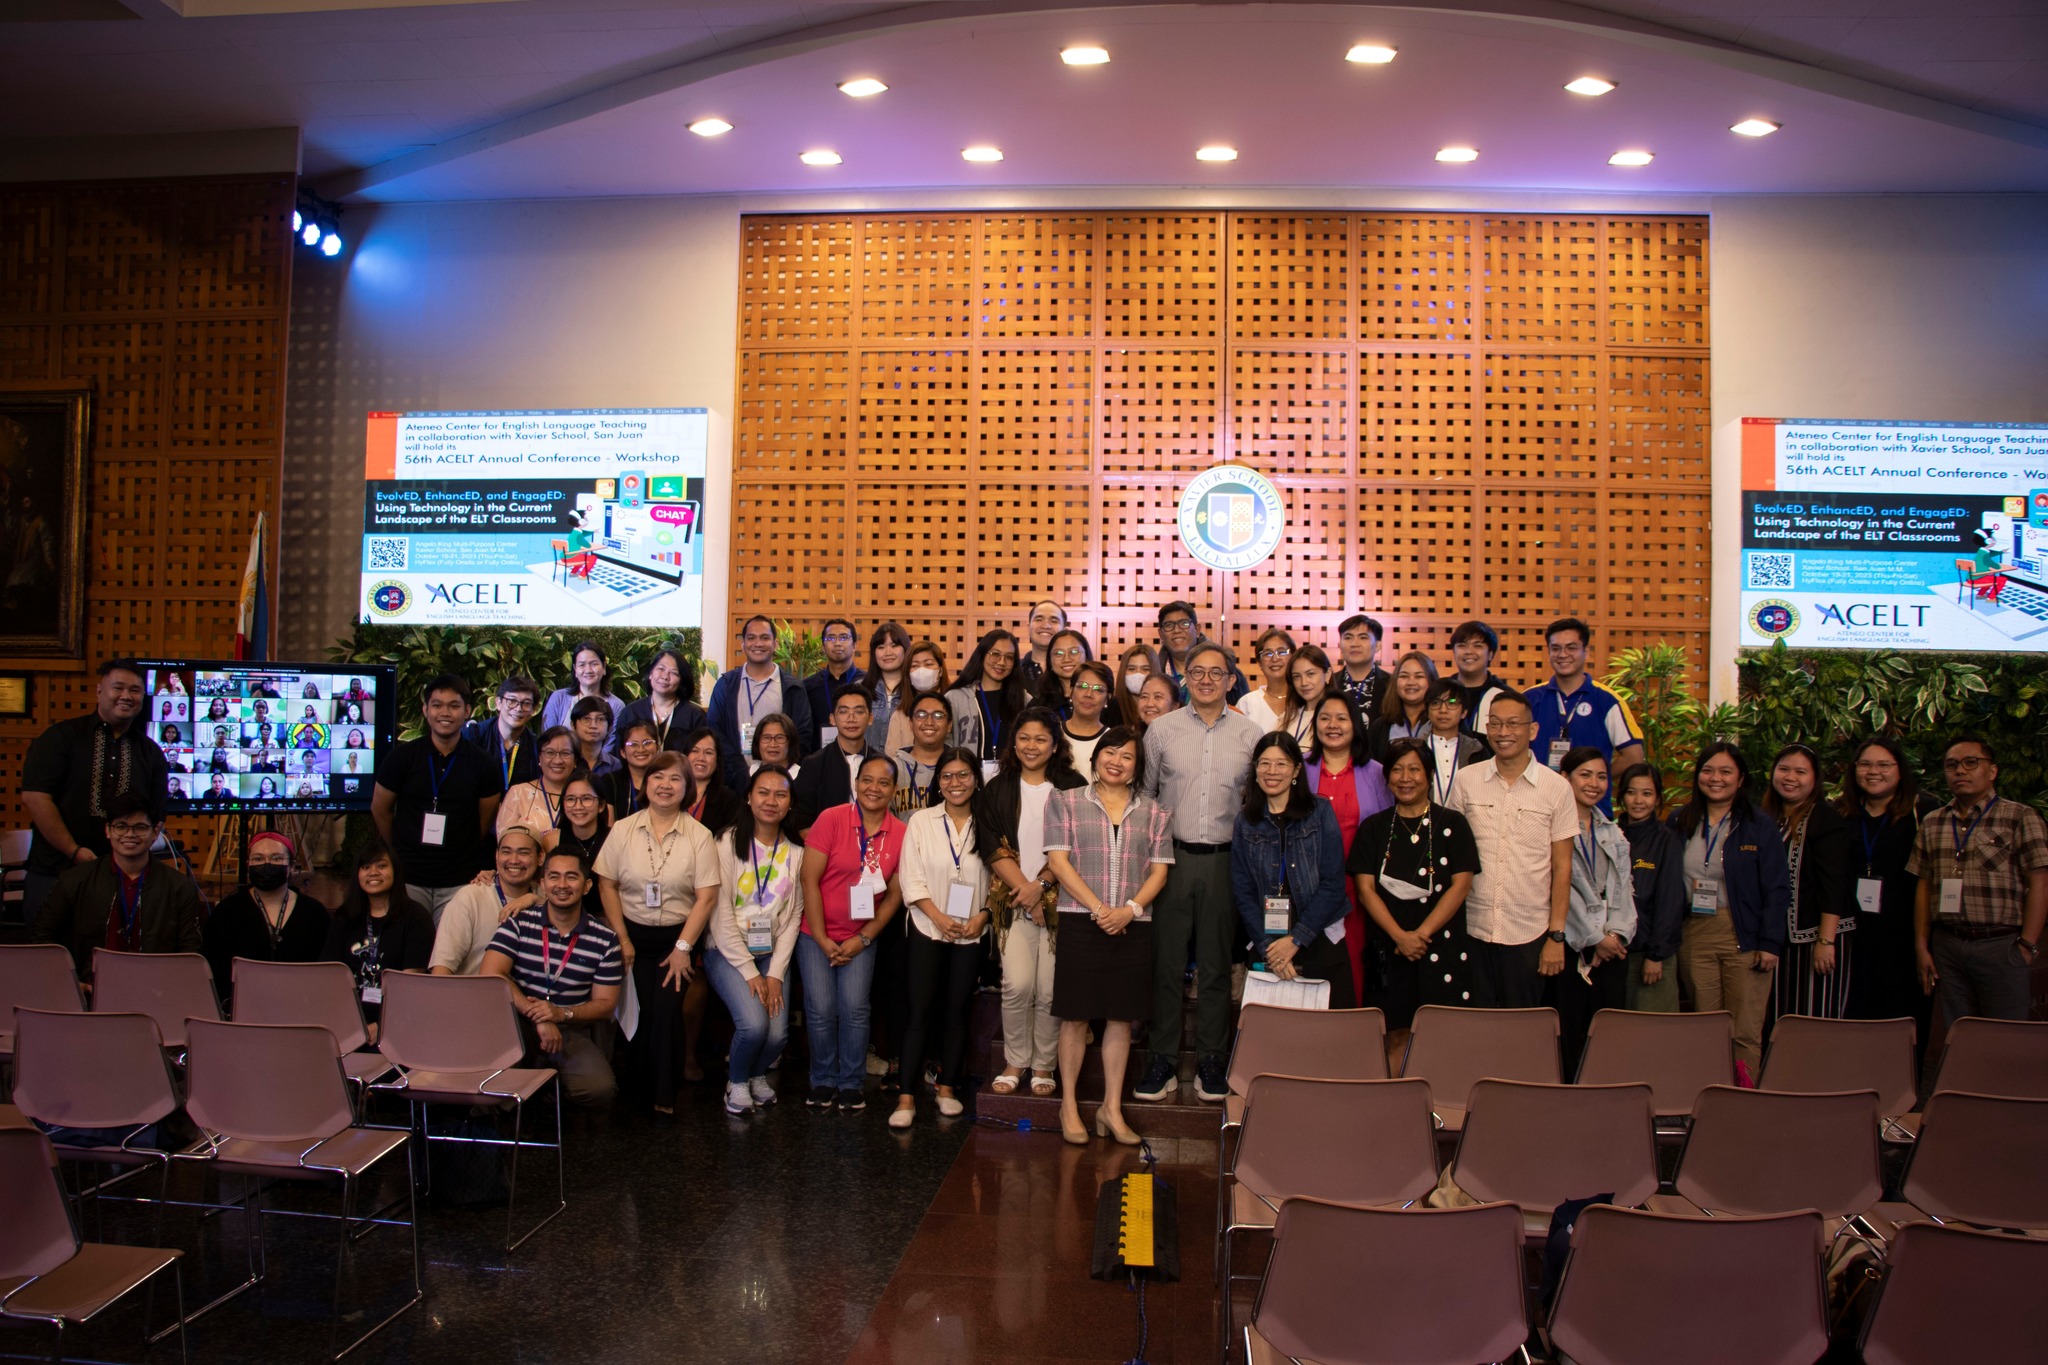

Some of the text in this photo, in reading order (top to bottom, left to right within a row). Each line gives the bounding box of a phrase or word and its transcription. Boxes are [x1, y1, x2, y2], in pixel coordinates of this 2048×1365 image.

[405, 420, 647, 432] Ateneo Center for English Language Teaching
[405, 431, 643, 441] in collaboration with Xavier School, San Juan
[1785, 431, 1828, 440] Ateneo
[1832, 431, 1872, 440] Center
[1875, 432, 1892, 441] for
[1896, 432, 1938, 443] English
[1942, 433, 2001, 445] Language
[404, 443, 457, 451] will hold its
[1786, 442, 2048, 455] in collaboration with Xavier School, San Jua
[404, 455, 432, 464] 56th
[436, 454, 475, 464] ACELT
[478, 453, 523, 463] Annual
[527, 453, 601, 463] Conference
[615, 452, 680, 464] Workshop
[1786, 453, 1845, 462] will hold its
[1785, 465, 1818, 475] 56th
[1823, 466, 1866, 476] ACELT
[1870, 466, 1921, 477] Annual
[1926, 467, 2008, 479] Conference
[2023, 469, 2048, 480] Wo
[376, 490, 566, 502] EvolvED, EnhancED, and EngagED:
[1183, 470, 1279, 514] XAVIER SCHOOL
[375, 503, 553, 514] Using Technology in the Current
[656, 509, 686, 520] CHAT
[1754, 504, 1970, 519] EvolvED, EnhancED, and EngagED:
[375, 514, 557, 526] Landscape of the ELT Classrooms
[1754, 517, 1955, 530] Using Technology in the Current
[1754, 529, 1961, 542] Landscape of the ELT Classrooms
[430, 583, 528, 604] ACELT
[1821, 603, 1931, 627] ACELT
